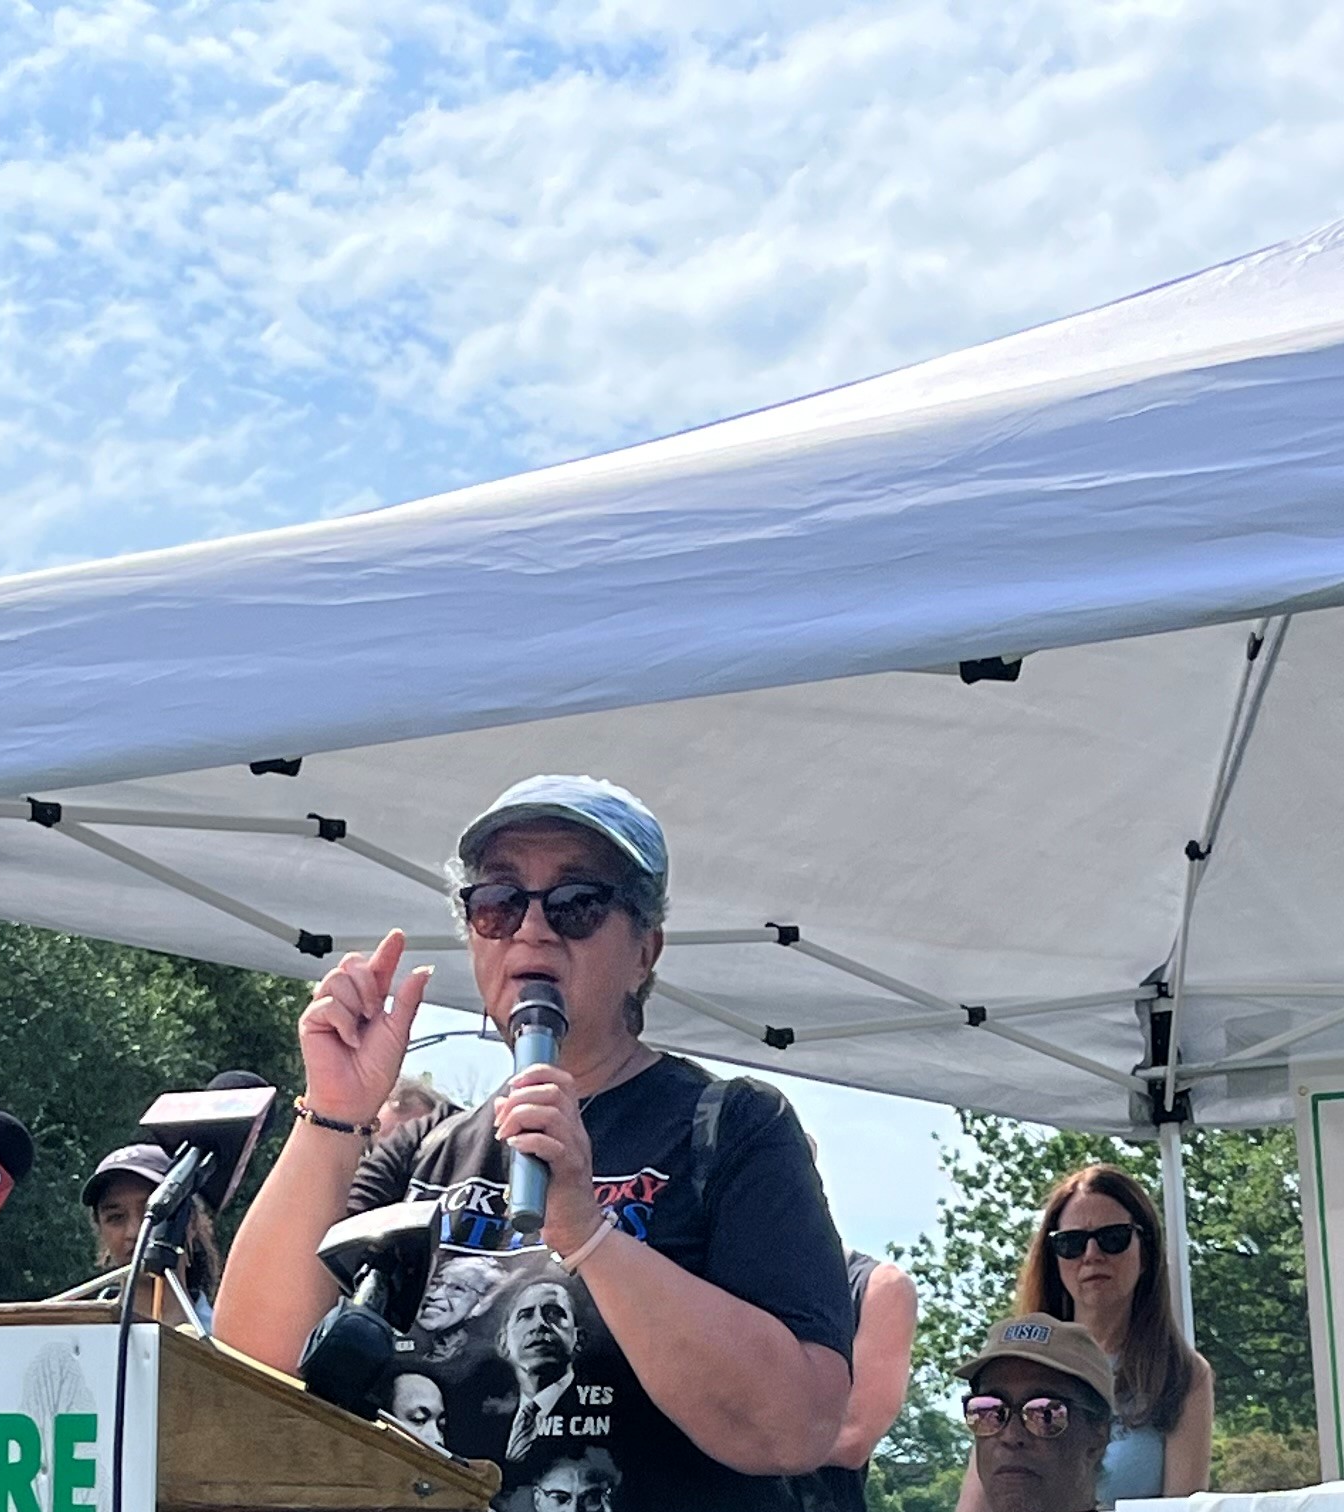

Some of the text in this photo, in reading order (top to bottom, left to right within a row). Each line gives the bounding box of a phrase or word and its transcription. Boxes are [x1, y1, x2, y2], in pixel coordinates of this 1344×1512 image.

[576, 1385, 614, 1405] YES
[536, 1416, 611, 1436] WE CAN
